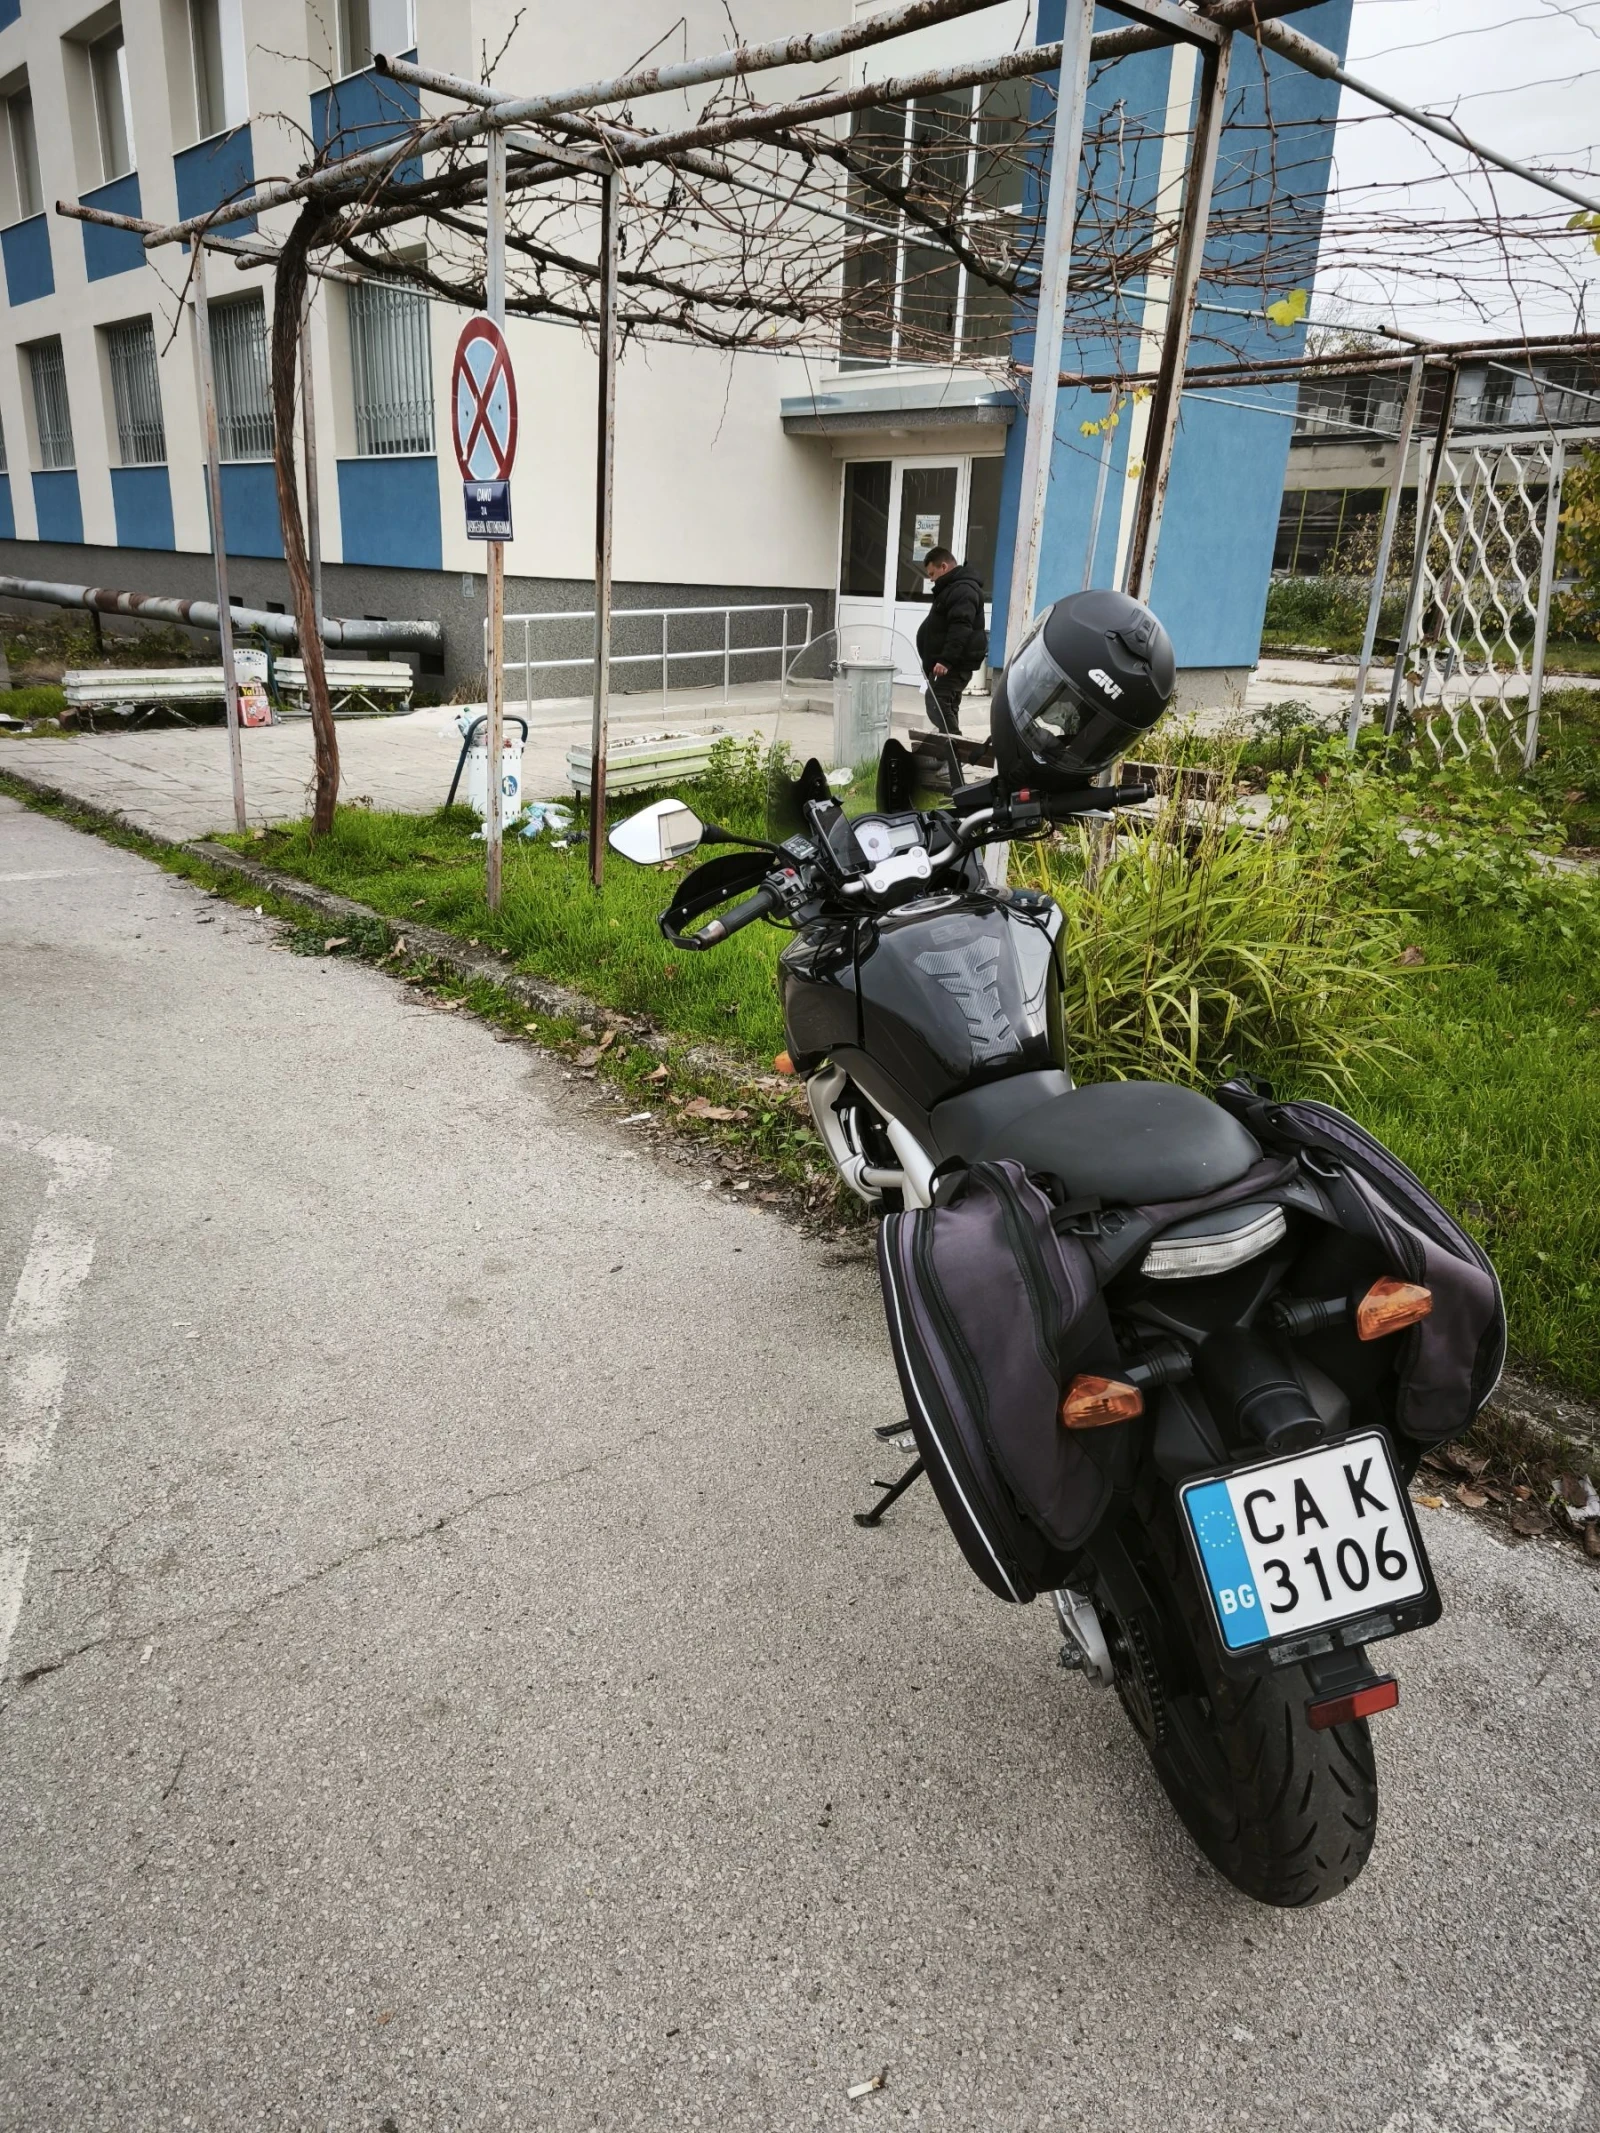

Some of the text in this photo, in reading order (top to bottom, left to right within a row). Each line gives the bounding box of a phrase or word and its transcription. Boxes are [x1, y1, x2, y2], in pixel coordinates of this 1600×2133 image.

[1088, 668, 1123, 700] GIVI
[1243, 1457, 1389, 1545] CA K
[1219, 1584, 1256, 1615] BG
[1263, 1526, 1408, 1614] 3106
